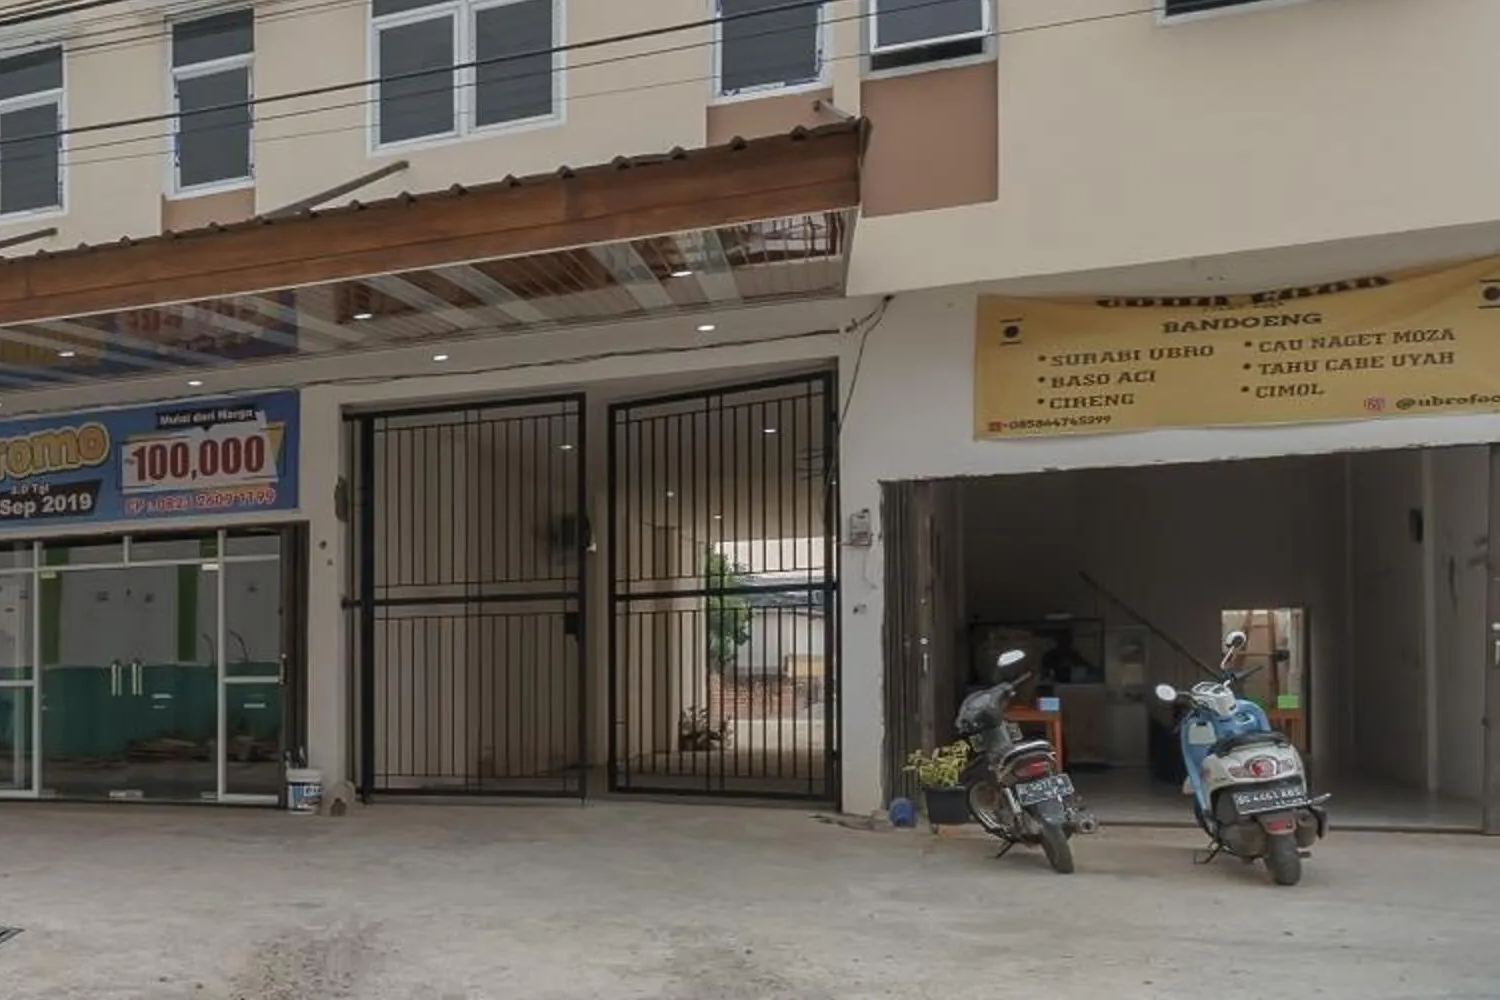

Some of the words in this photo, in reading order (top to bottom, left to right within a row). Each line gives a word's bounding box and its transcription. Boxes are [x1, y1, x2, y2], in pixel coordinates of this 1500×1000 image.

[1161, 312, 1323, 334] BANDOENG
[1258, 339, 1304, 354] CAU
[1310, 332, 1386, 350] NAGET
[1392, 328, 1456, 345] MOZA
[1050, 349, 1141, 367] SURABI
[1148, 345, 1215, 361] UBRO
[1257, 359, 1318, 376] TAHU
[1325, 355, 1385, 372] CABE
[1391, 352, 1456, 368] UYAH
[1051, 373, 1111, 389] BASO
[1117, 370, 1157, 385] ACI
[1049, 393, 1136, 410] CIRENG
[1255, 383, 1326, 399] CIMOL
[160, 413, 190, 425] Mulai
[218, 409, 253, 422] Harga
[131, 435, 265, 481] 100,000
[0, 498, 37, 518] Sep
[41, 492, 93, 513] 2019
